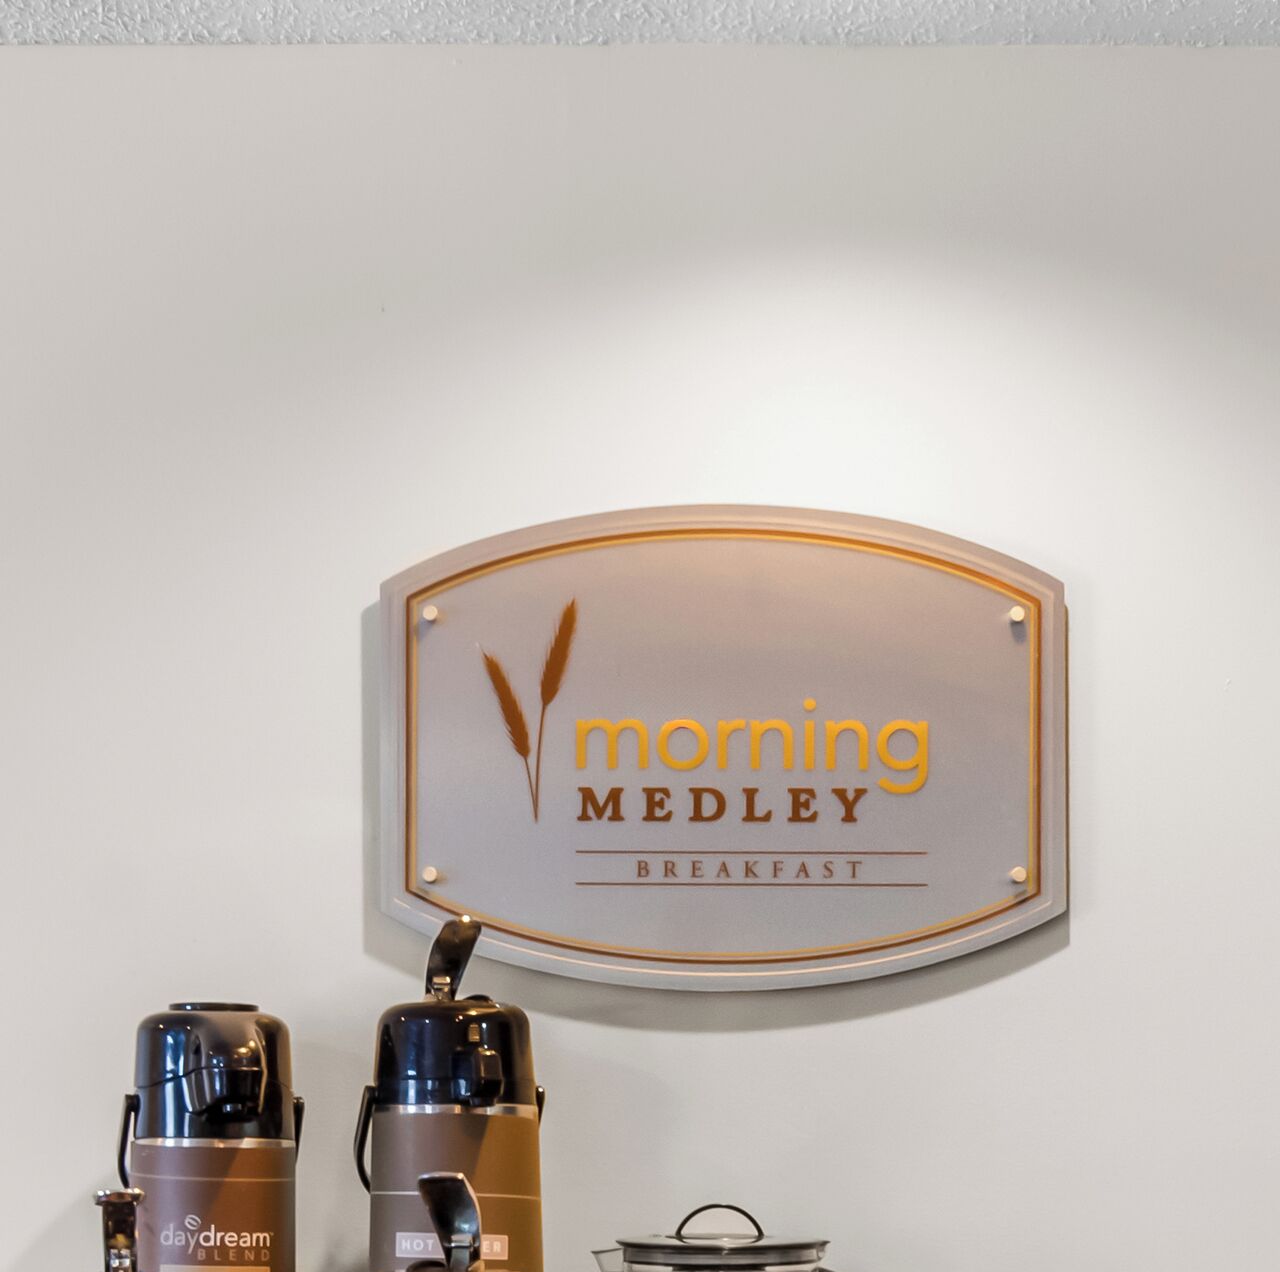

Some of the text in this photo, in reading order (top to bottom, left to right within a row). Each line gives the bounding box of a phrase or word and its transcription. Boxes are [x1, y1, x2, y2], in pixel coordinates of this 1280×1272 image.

[575, 697, 930, 794] morning
[576, 786, 868, 823] MEDLEY
[636, 860, 864, 880] BREAKFAST
[197, 1248, 271, 1261] BLEND
[401, 1239, 434, 1252] HOT
